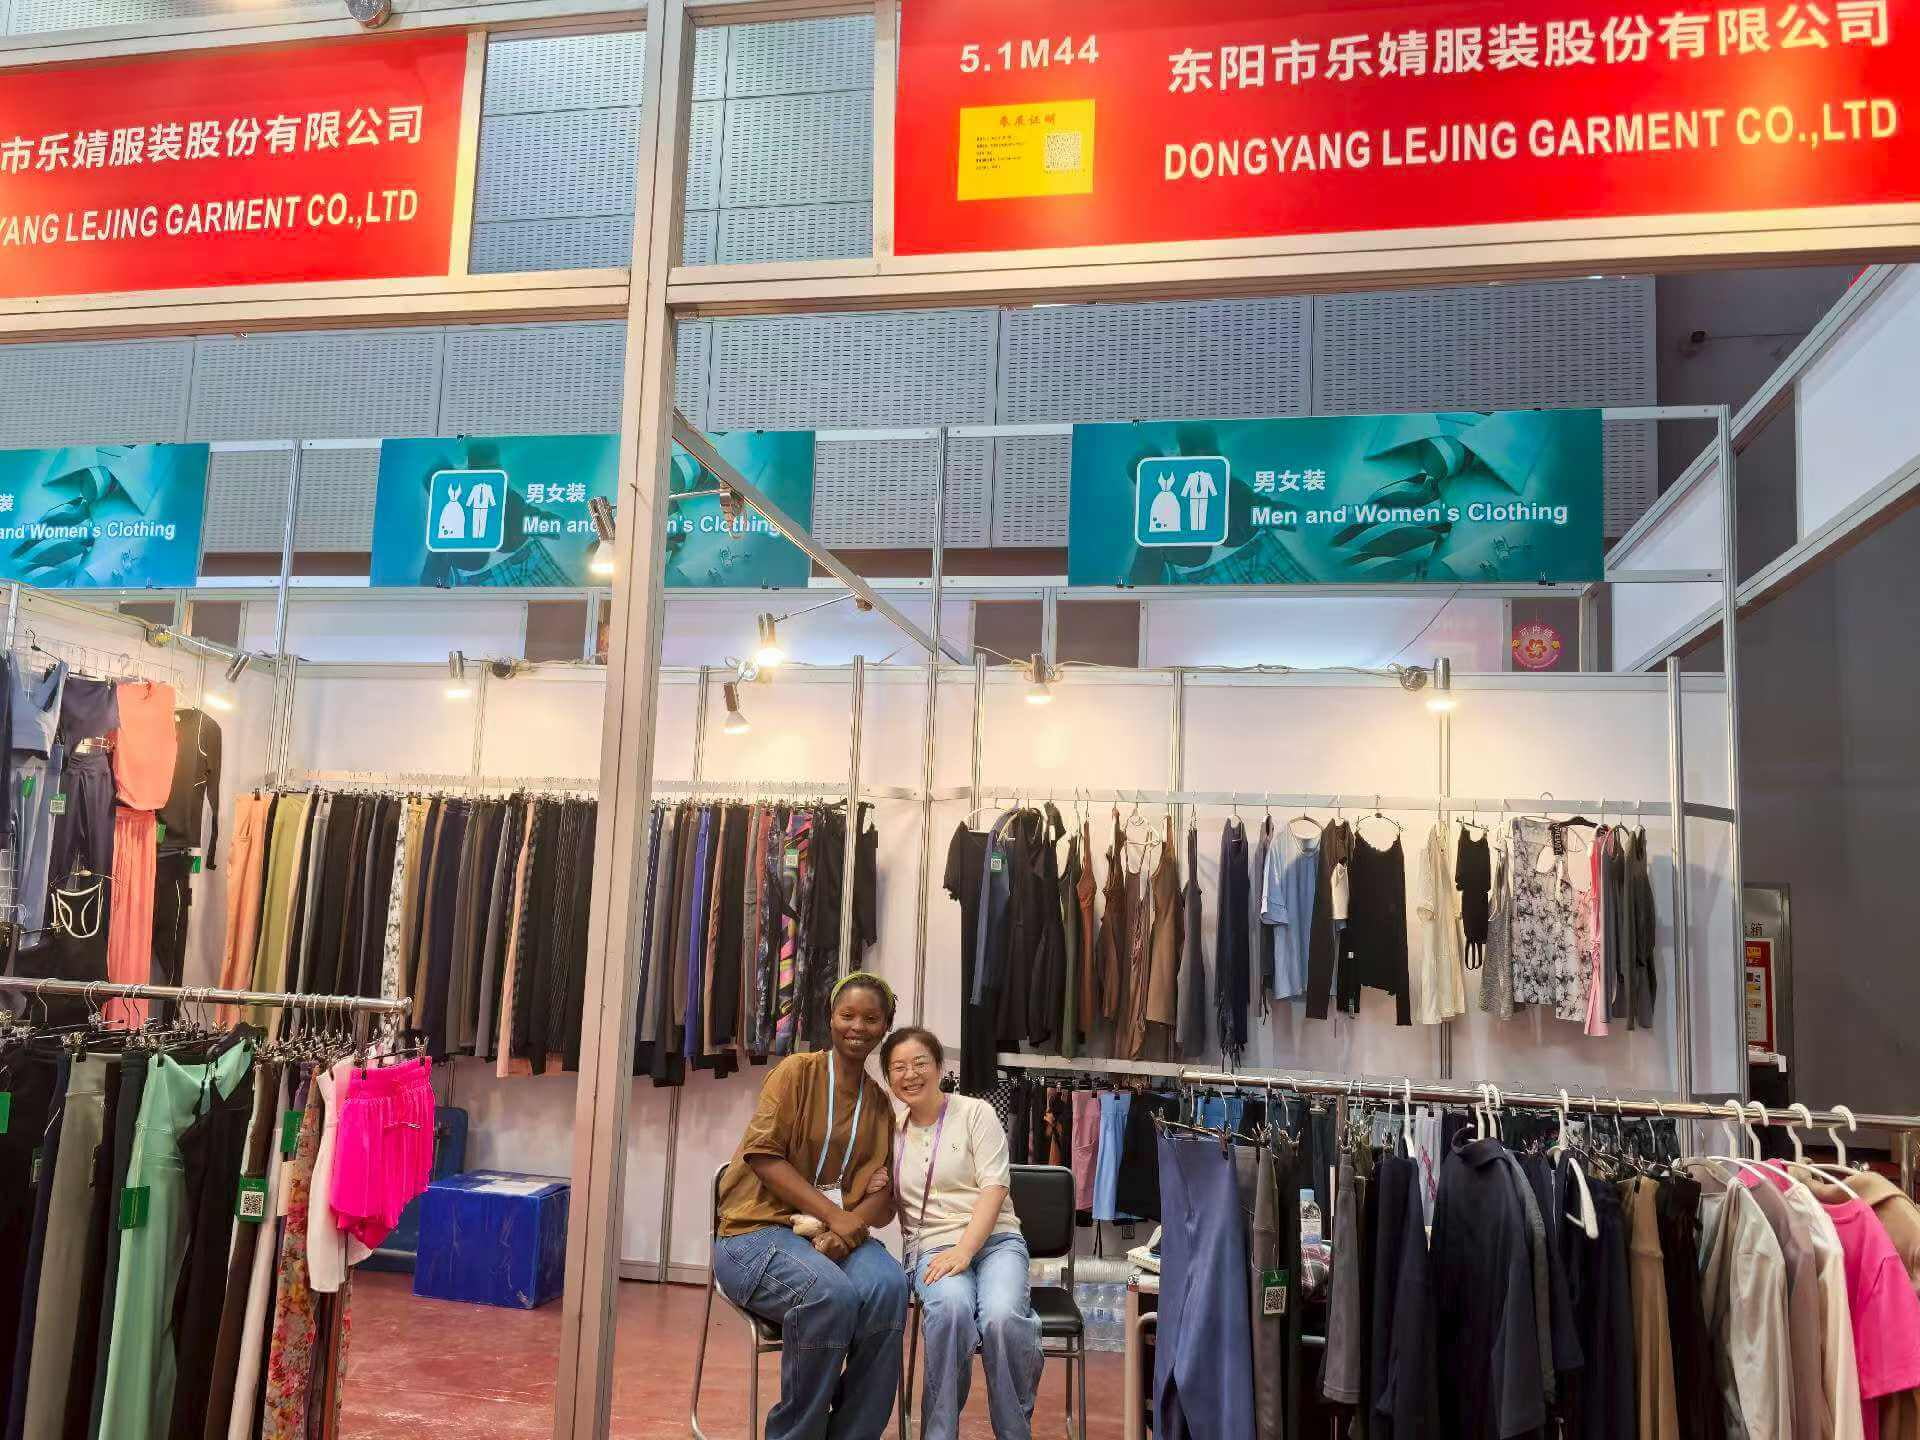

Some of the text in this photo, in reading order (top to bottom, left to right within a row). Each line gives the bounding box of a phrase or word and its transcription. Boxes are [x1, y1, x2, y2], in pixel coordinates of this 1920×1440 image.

[960, 34, 1100, 73] 5.1M44
[1167, 0, 1890, 94] 东阳市乐婧服装股份有限公司
[0, 105, 423, 175] 市乐婧服装股份有限公司
[1164, 99, 1897, 181] DONGYANG LEJING GARMENT CO.,LTD
[65, 206, 159, 242] LEJING
[165, 196, 301, 235] GARMENT
[307, 189, 418, 230] CO.,LTD
[526, 482, 587, 504] 男女装
[1254, 469, 1326, 493] 男女装
[523, 516, 561, 533] Men
[1252, 502, 1568, 525] Men and Women's Clothing
[30, 523, 102, 539] Women's
[107, 522, 176, 540] Clothing
